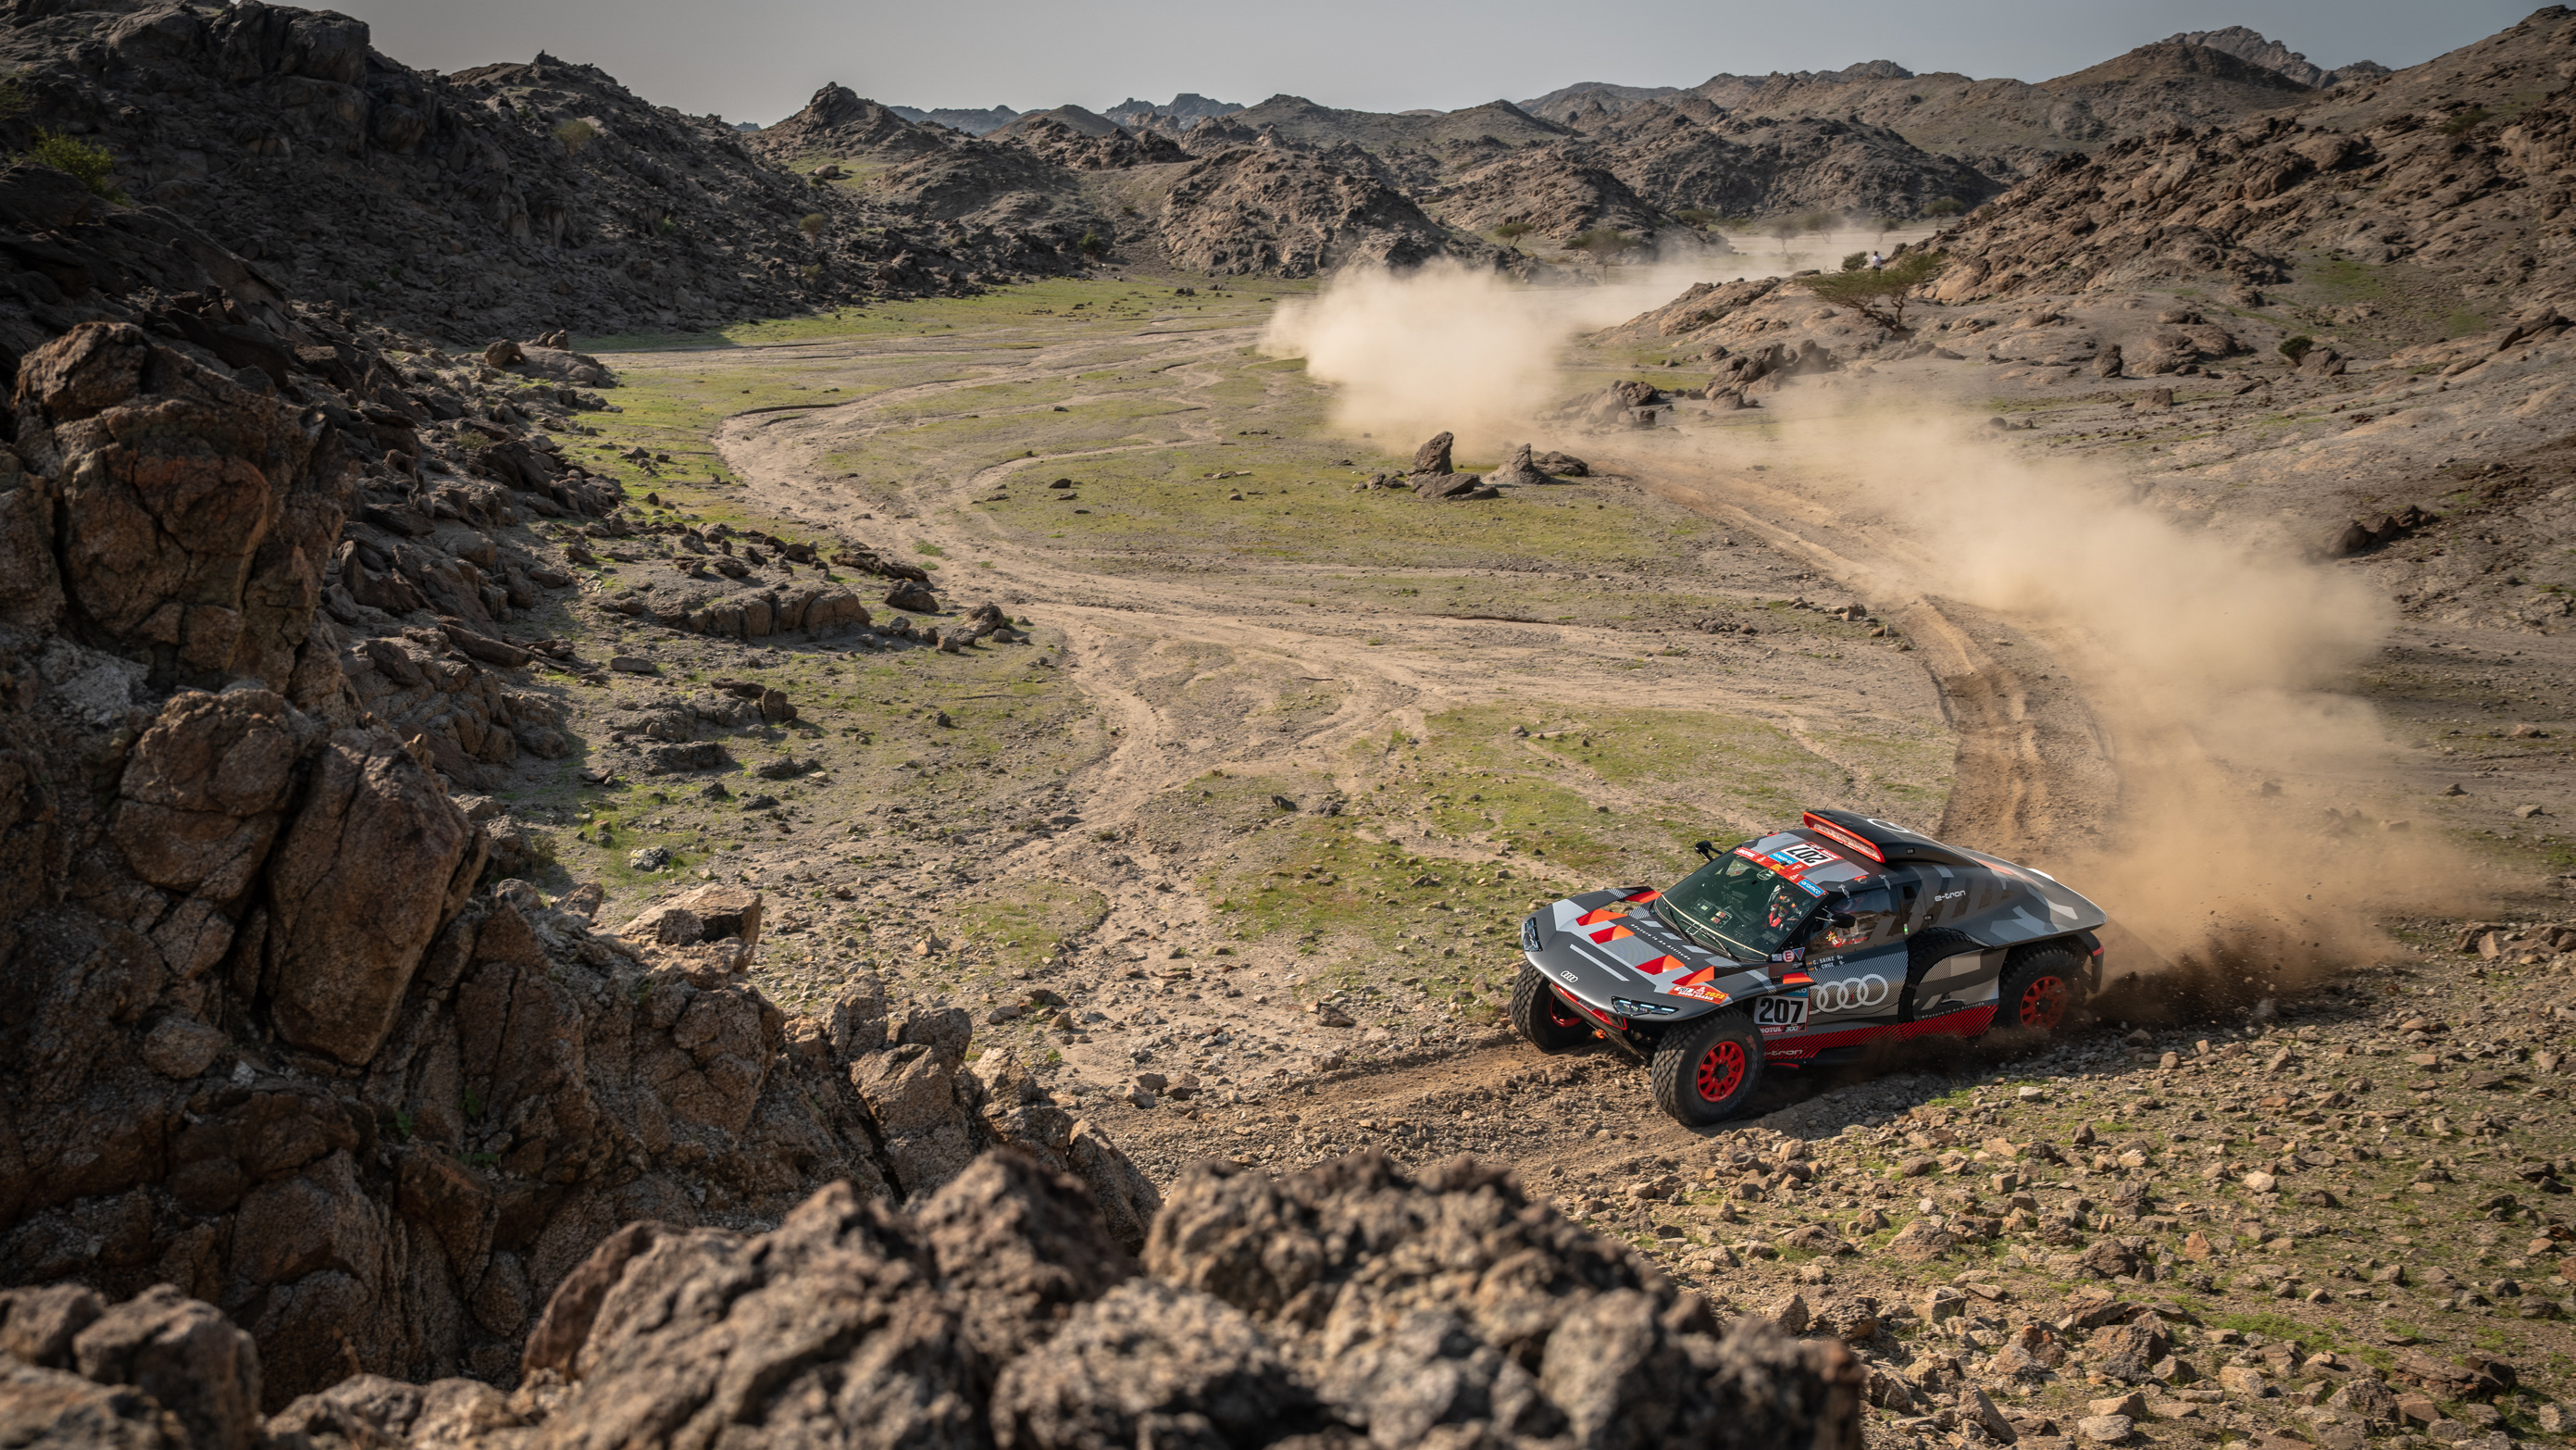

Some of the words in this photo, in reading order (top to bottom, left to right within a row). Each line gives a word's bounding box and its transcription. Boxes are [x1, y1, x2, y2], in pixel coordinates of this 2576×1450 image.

[1786, 846, 1829, 864] 207
[1801, 881, 1821, 894] aramco
[1935, 890, 1966, 902] e-tron
[1785, 951, 1792, 960] E
[1819, 956, 1835, 964] SAINZ
[1704, 991, 1725, 999] 2023
[1759, 997, 1804, 1023] 207
[1960, 1002, 1985, 1010] Attitude
